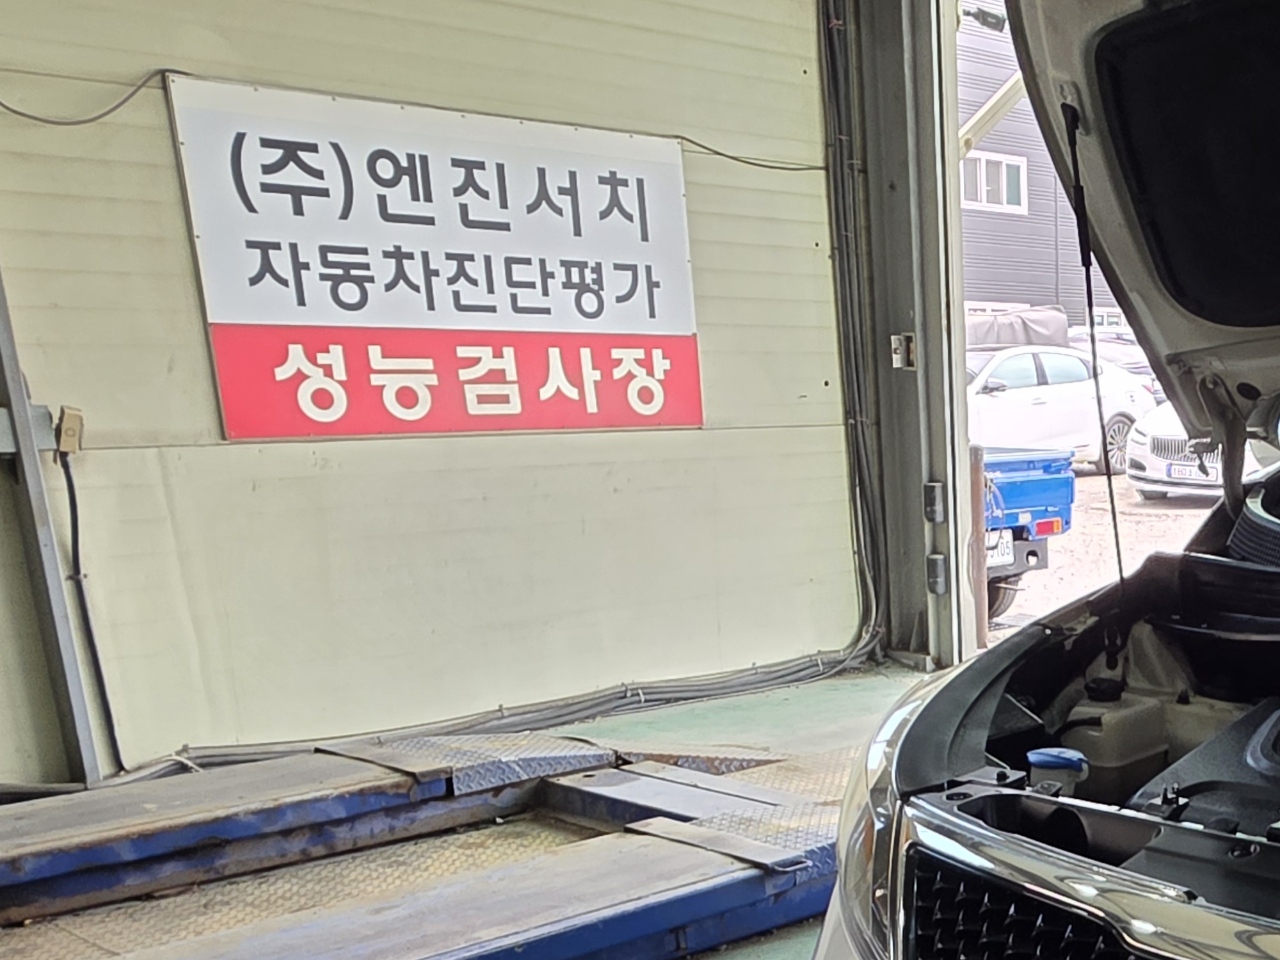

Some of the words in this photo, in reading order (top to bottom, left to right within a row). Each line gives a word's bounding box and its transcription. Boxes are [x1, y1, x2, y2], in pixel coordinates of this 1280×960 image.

[231, 131, 650, 243] (주)엔진서치
[244, 239, 662, 320] 자동차진단평가
[273, 343, 671, 423] 성능검사장
